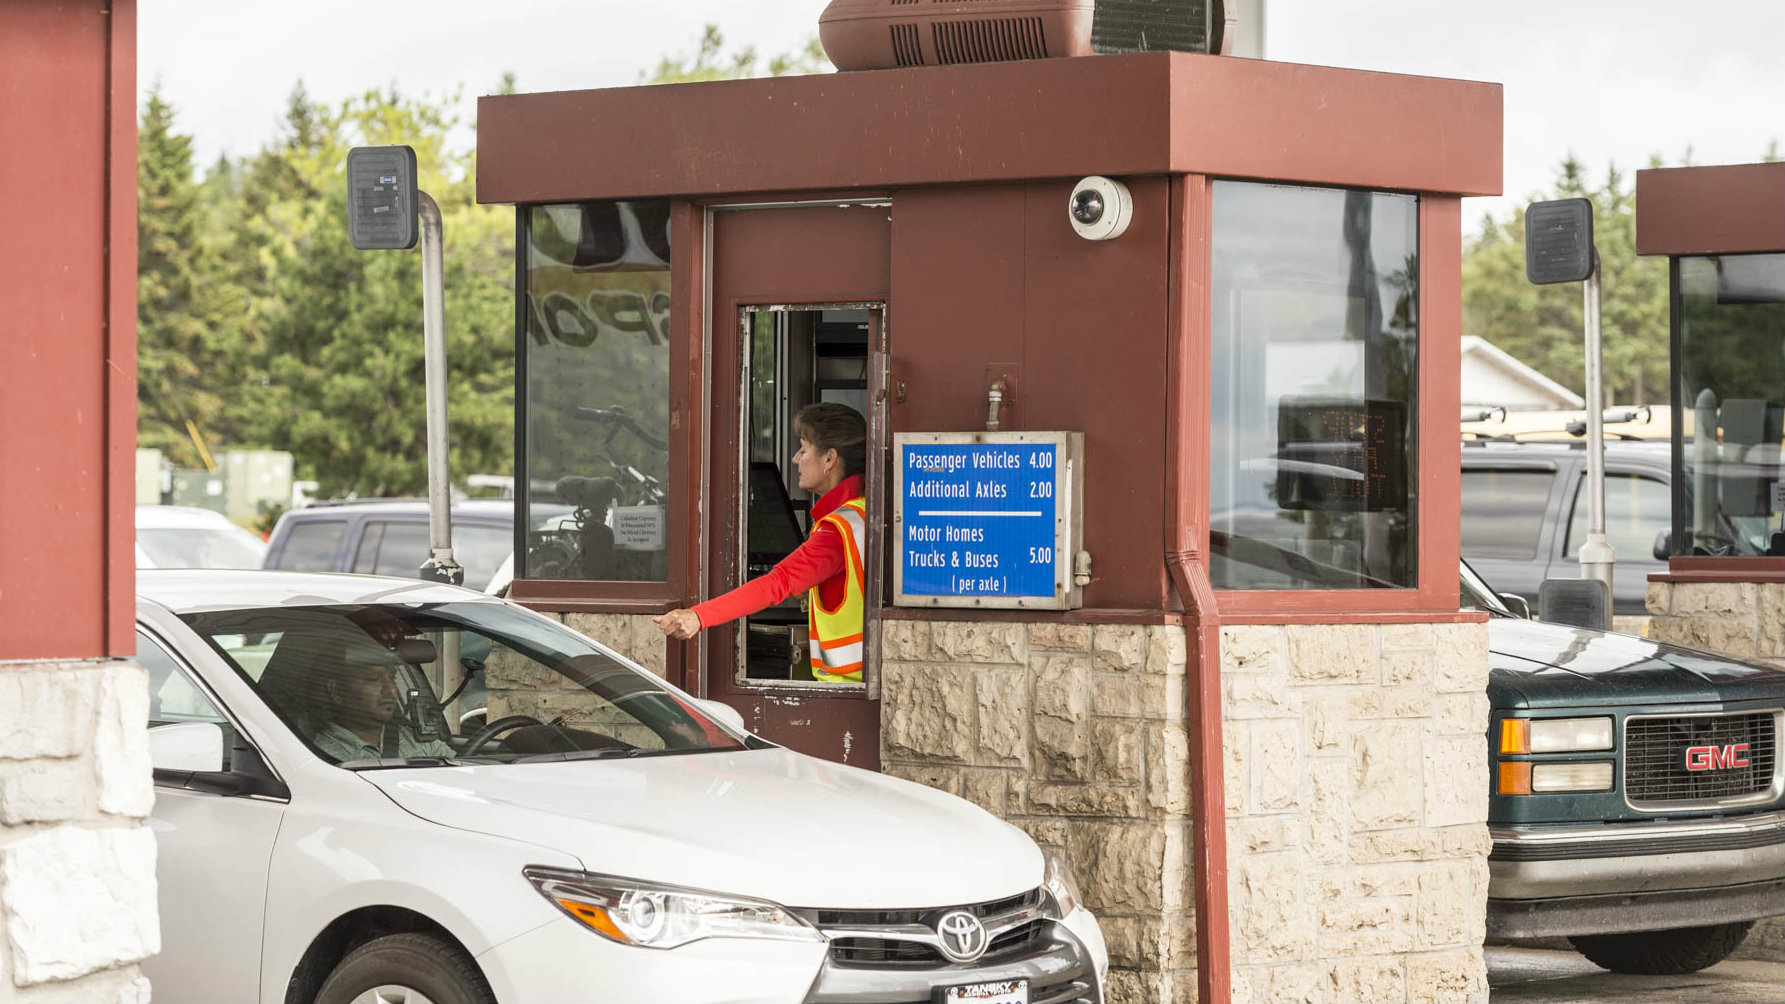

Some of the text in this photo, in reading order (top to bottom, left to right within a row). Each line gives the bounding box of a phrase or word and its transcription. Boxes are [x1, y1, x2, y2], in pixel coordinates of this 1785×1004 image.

[909, 451, 1052, 473] Passenger Vehicles 4.00
[910, 480, 1051, 498] Additional Axles 2.00
[909, 525, 983, 542] Motor Homes
[909, 547, 1051, 567] Trucks & Buses 5.00
[979, 577, 999, 591] axle
[1686, 743, 1749, 771] GMC
[964, 982, 1012, 993] TANSKY
